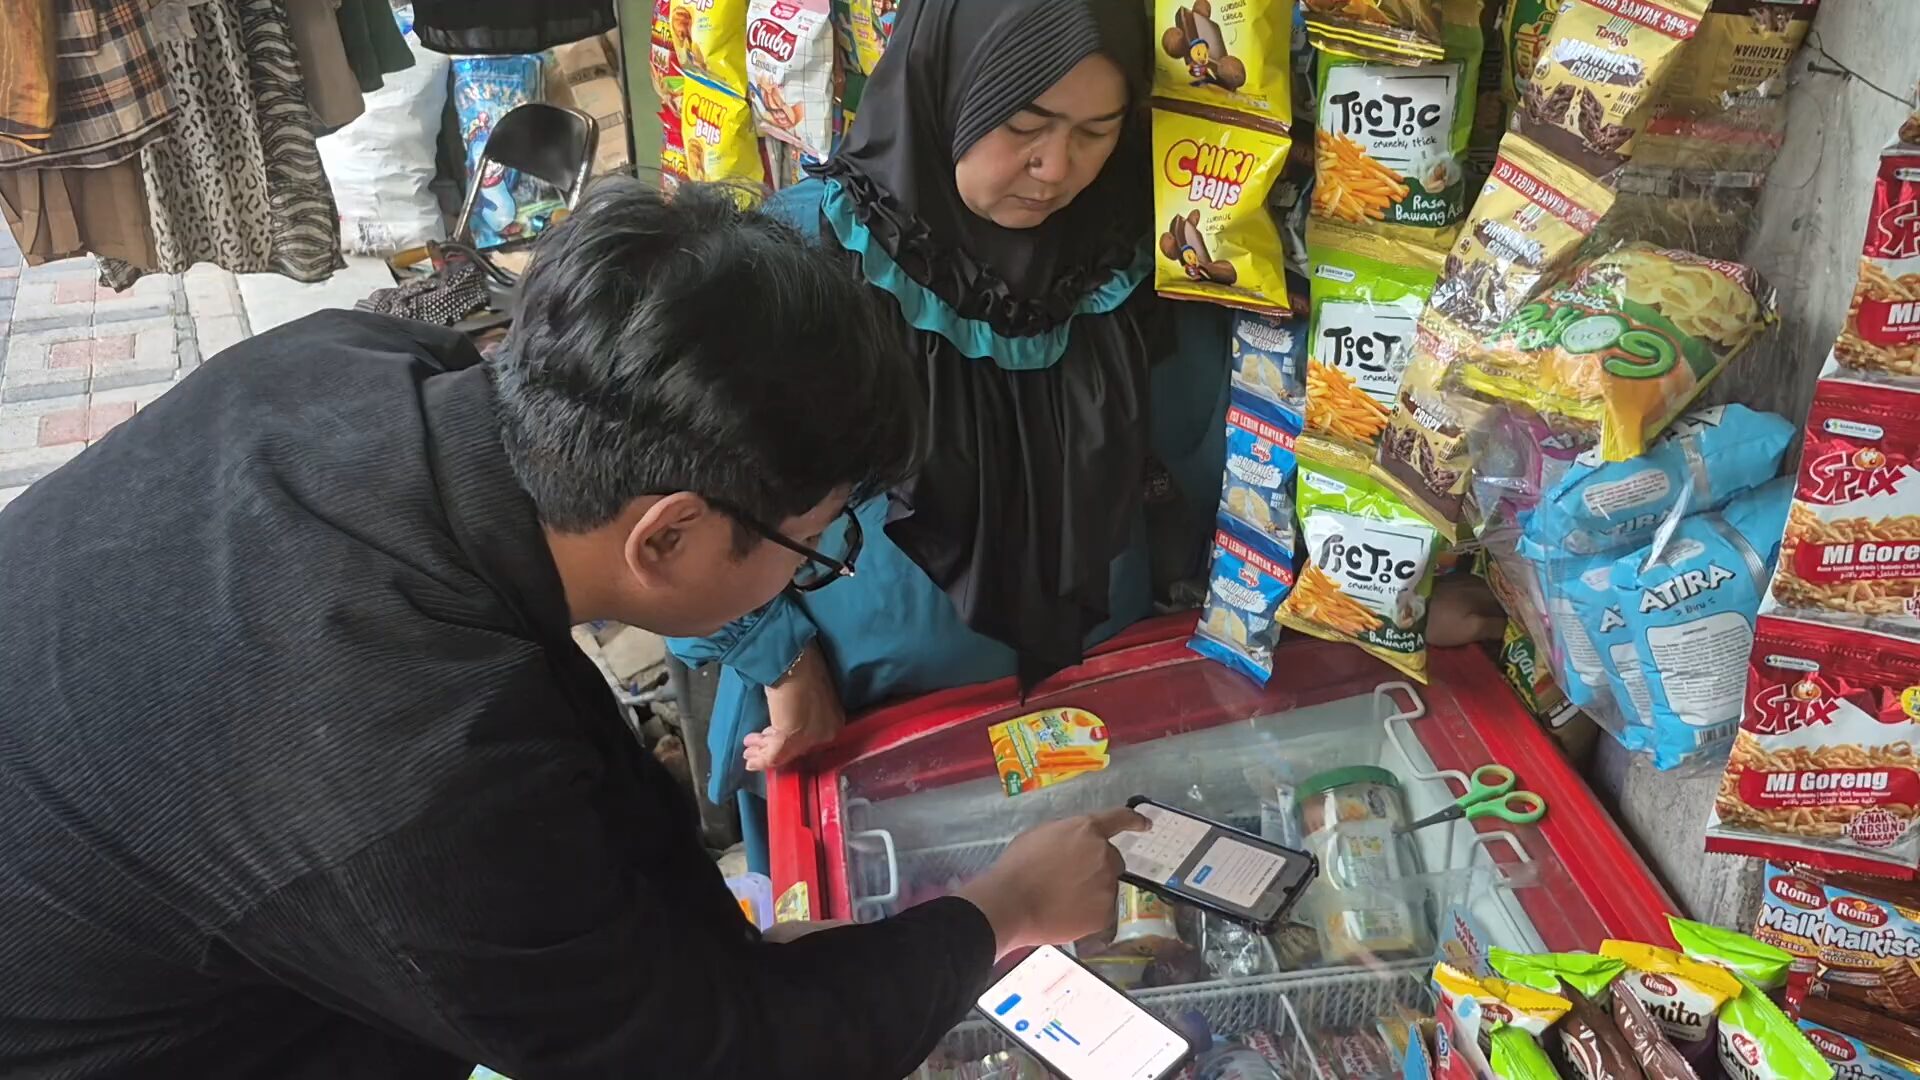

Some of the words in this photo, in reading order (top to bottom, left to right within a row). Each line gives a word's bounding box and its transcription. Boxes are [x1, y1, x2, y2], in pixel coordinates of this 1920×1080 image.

[750, 21, 792, 61] Chuba
[1596, 24, 1629, 48] Tango
[1569, 61, 1614, 84] CRISPY
[685, 93, 728, 128] CHIKI
[695, 121, 721, 145] Balls
[1373, 137, 1409, 149] crunchy
[1412, 136, 1438, 148] stick
[1164, 139, 1256, 187] CHIKI
[1189, 175, 1242, 210] Balls
[1413, 195, 1447, 210] Rasa
[1395, 204, 1446, 226] Bawang
[1245, 320, 1285, 345] BROWNIES
[1323, 326, 1402, 366] TicT
[1363, 373, 1398, 384] crunchy
[1412, 407, 1442, 432] CRISPY
[1252, 444, 1271, 462] Tango
[1234, 455, 1275, 480] BROWNIES
[1821, 544, 1854, 565] Mi
[1858, 543, 1920, 563] Gore
[1221, 579, 1261, 605] BROWNIES
[1348, 581, 1384, 594] crunchy
[1638, 563, 1736, 614] ATIRA
[1369, 631, 1415, 652] Bawang
[1386, 628, 1416, 640] Rasa
[1766, 773, 1796, 792] Mi
[1799, 771, 1889, 791] Goreng
[1843, 821, 1906, 835] LANGSUNG
[1861, 814, 1888, 824] ENAK
[1775, 880, 1821, 908] Roma
[1836, 902, 1880, 925] Roma
[1758, 902, 1825, 948] Malk
[1822, 923, 1920, 959] Malkist
[1645, 975, 1674, 995] Roma
[1641, 999, 1702, 1027] nita
[1809, 1032, 1849, 1060] Roma
